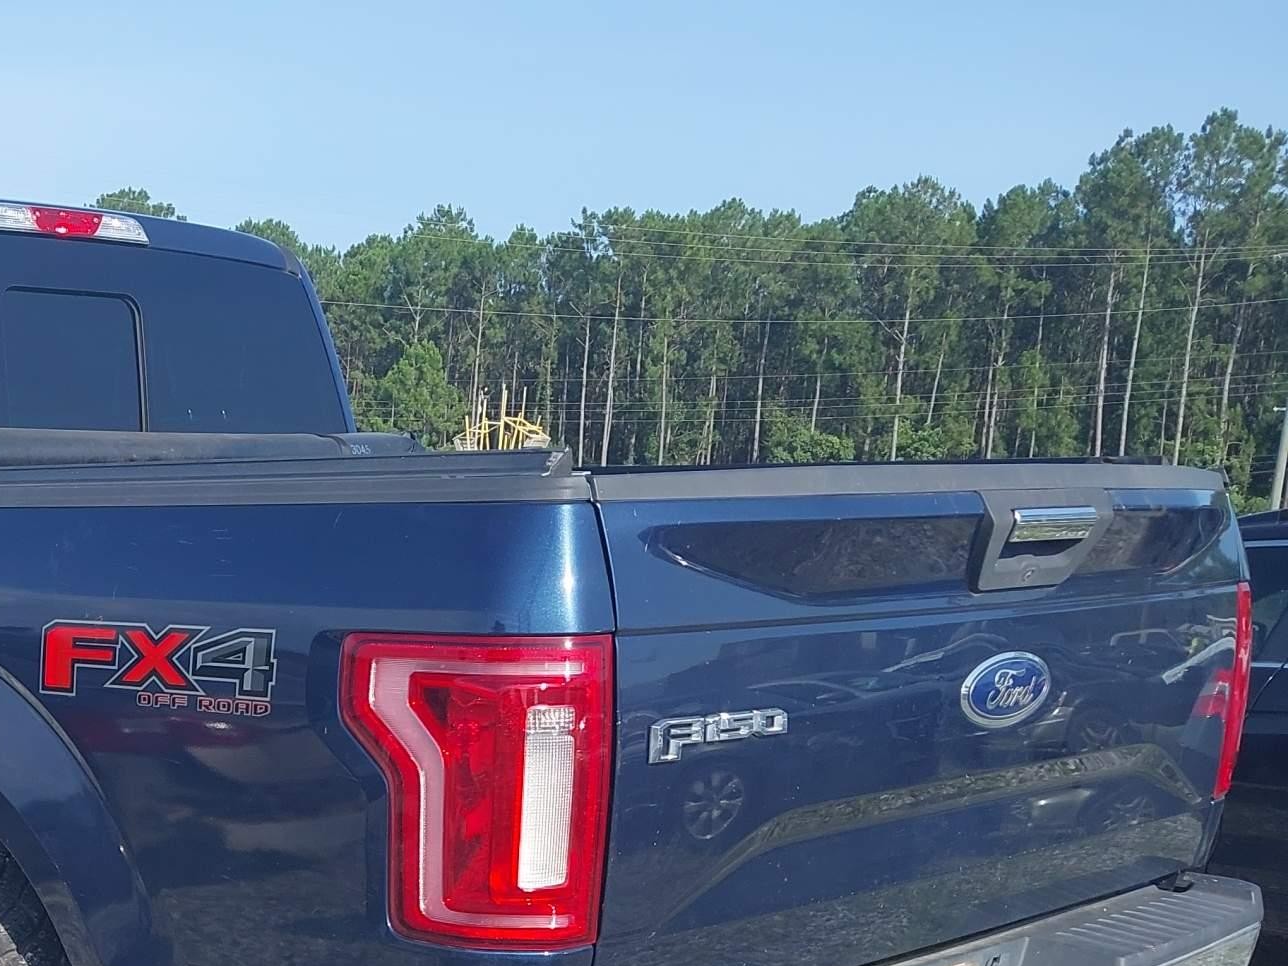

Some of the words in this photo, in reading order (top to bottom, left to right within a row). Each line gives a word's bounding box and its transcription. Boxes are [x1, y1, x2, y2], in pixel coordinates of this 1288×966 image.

[40, 619, 277, 701] FX4
[136, 692, 188, 709] OFF
[197, 696, 272, 717] ROAD
[985, 667, 1036, 711] Ford
